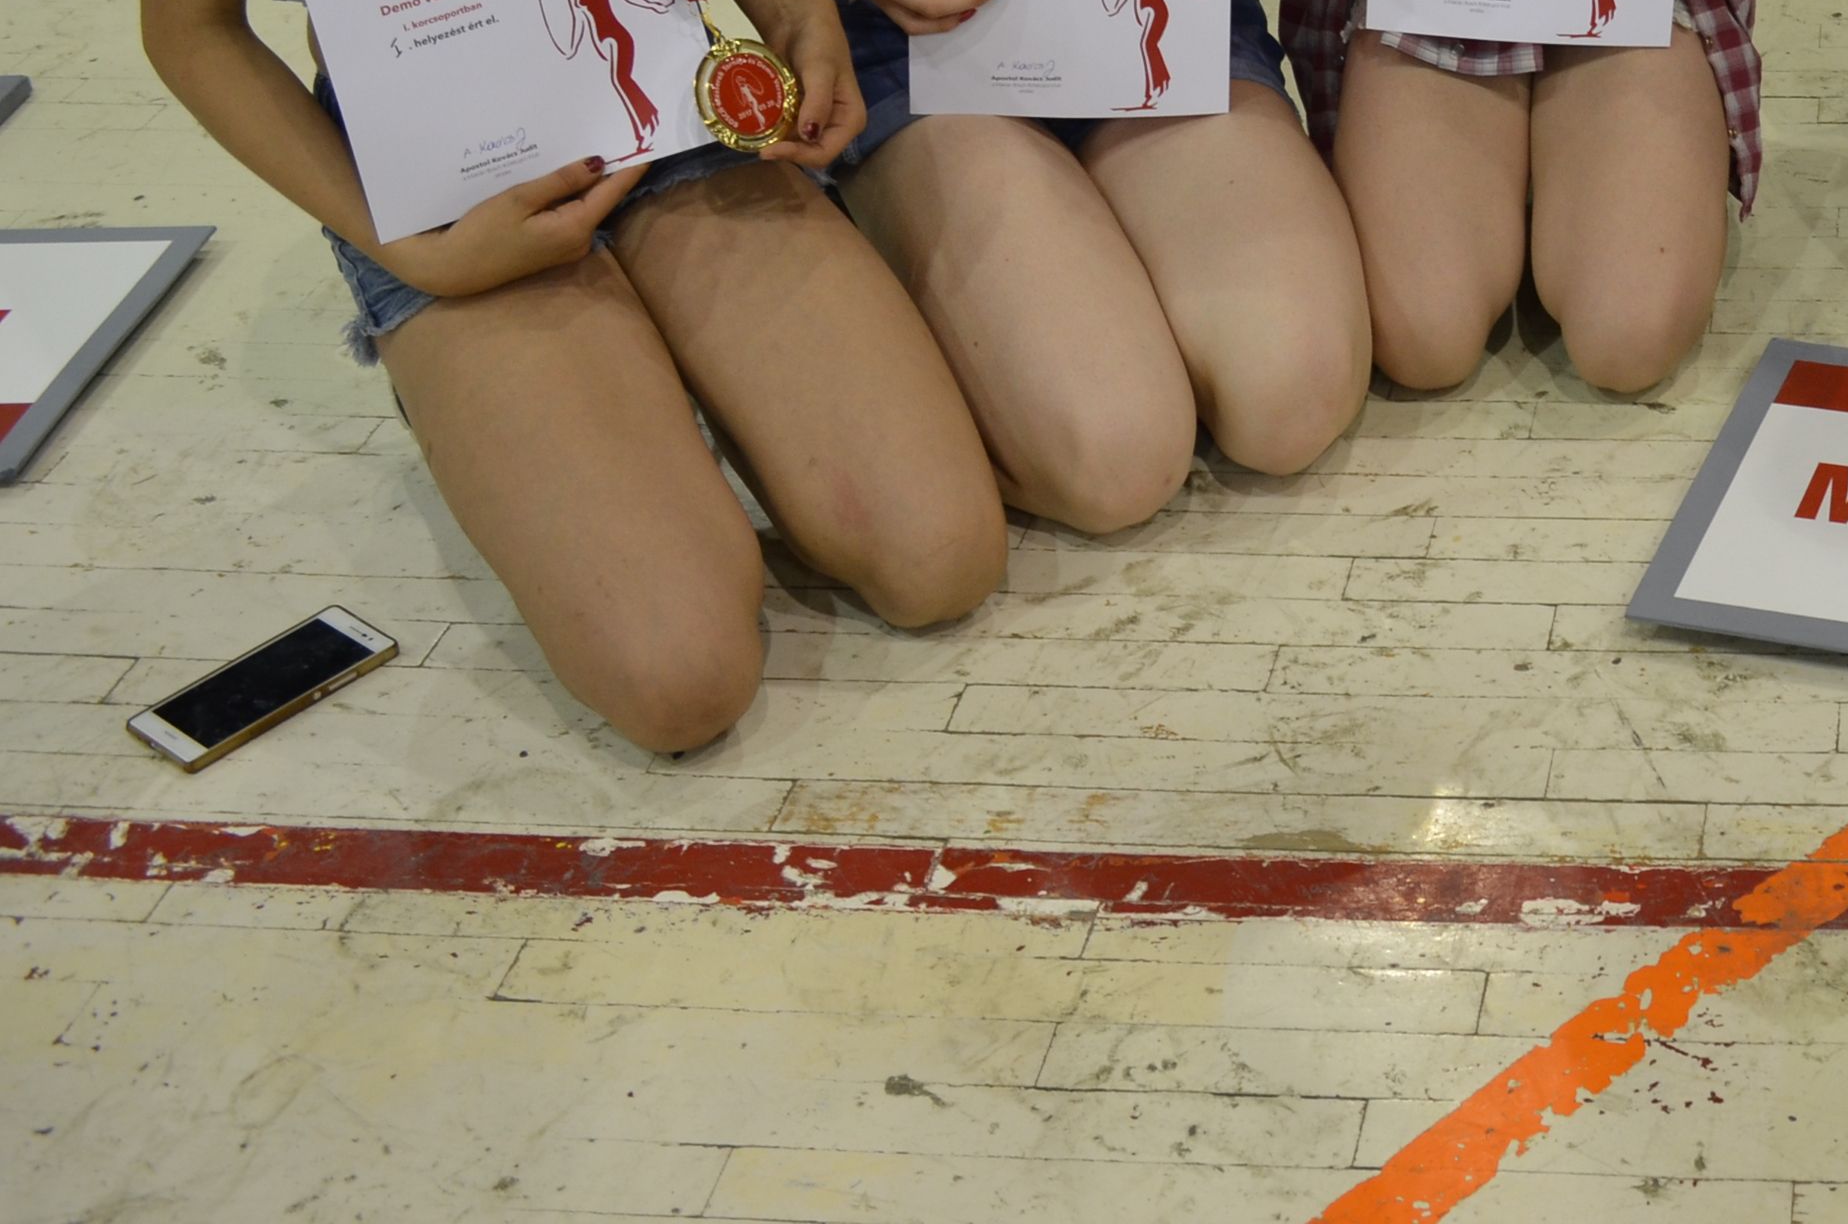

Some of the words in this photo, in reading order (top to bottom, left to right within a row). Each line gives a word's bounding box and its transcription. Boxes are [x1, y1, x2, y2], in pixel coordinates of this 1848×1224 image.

[411, 3, 482, 28] korcsoportban
[413, 25, 465, 47] helyezést
[468, 20, 483, 30] ért
[485, 14, 499, 25] el.
